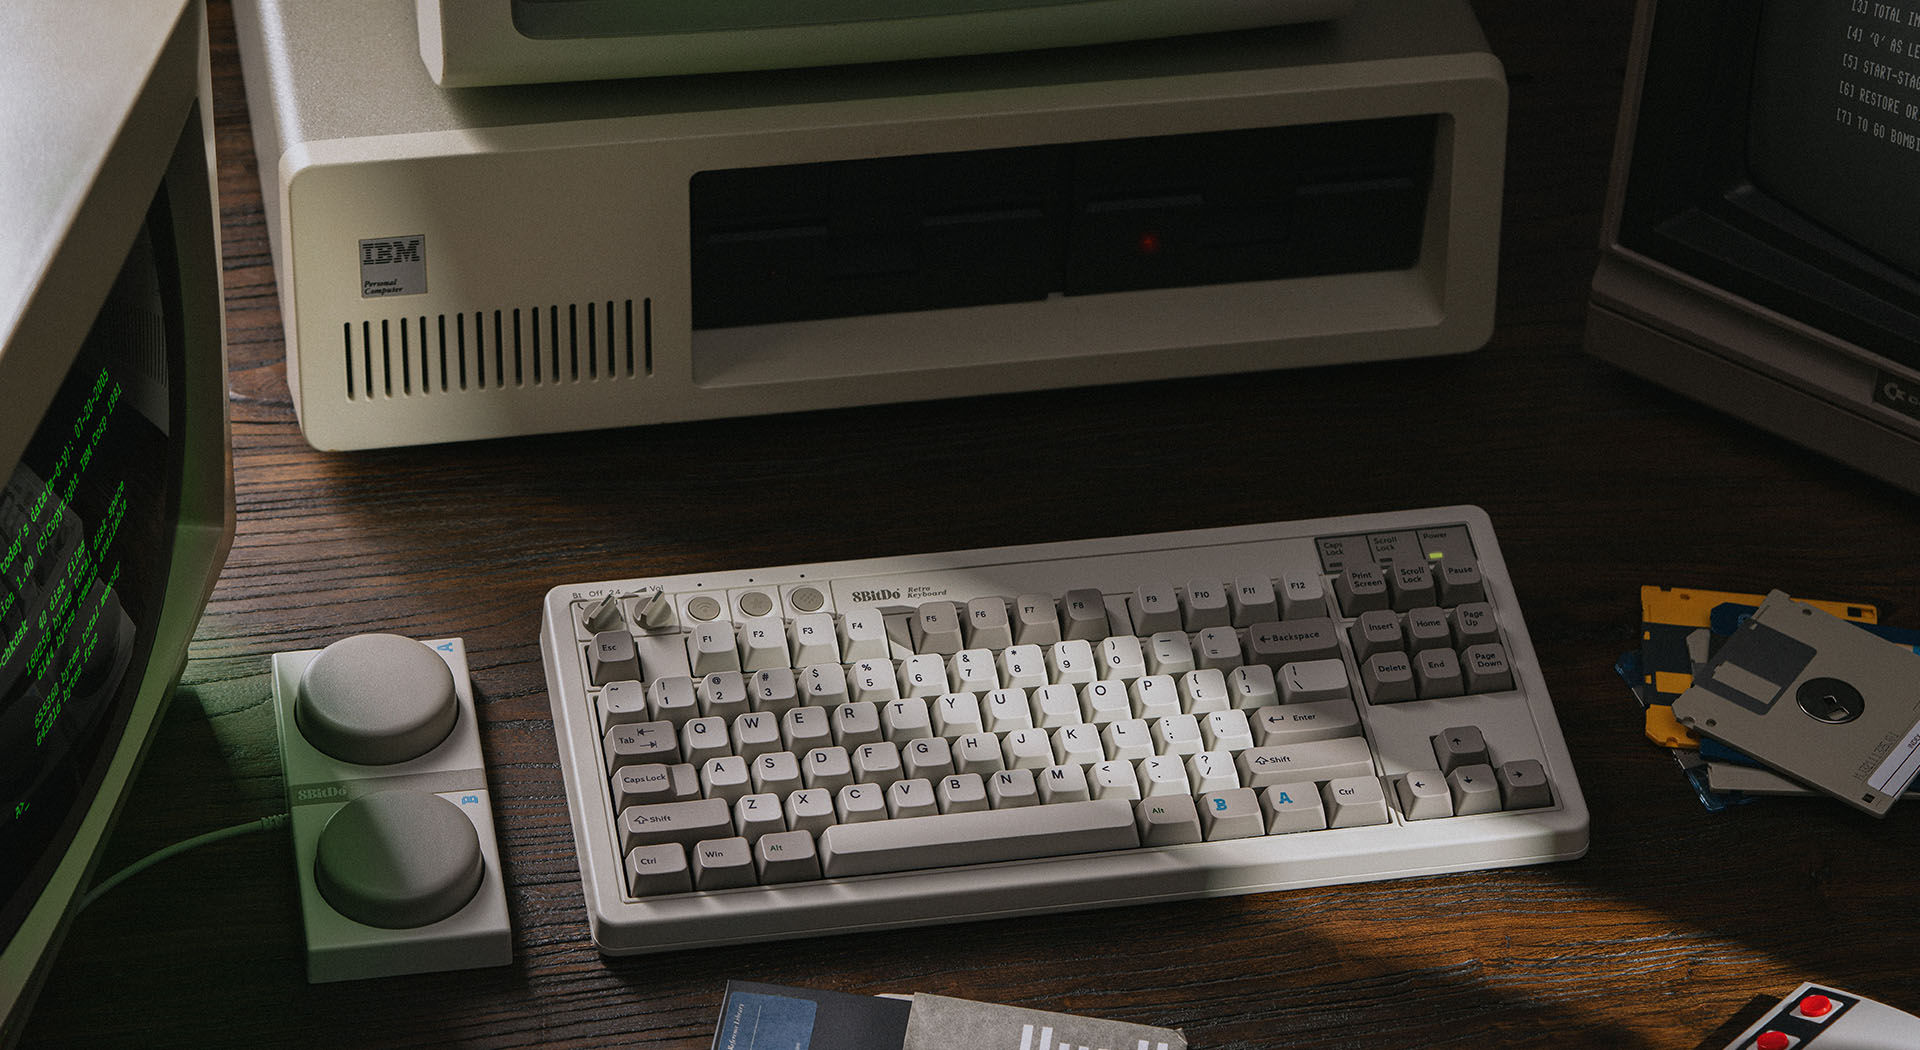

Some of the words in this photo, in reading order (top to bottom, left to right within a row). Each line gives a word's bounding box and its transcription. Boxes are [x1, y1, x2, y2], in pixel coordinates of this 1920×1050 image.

[1873, 3, 1901, 23] TOTAL
[1847, 26, 1863, 42] [4]
[1890, 38, 1903, 54] AS
[1843, 53, 1858, 70] [5]
[1839, 81, 1854, 98] [6]
[1859, 88, 1900, 114] RESTORE
[1905, 104, 1920, 121] OR
[1836, 107, 1852, 125] [7]
[1857, 116, 1869, 132] TO
[1873, 122, 1885, 138] GO
[362, 240, 420, 265] IBM
[364, 278, 398, 288] Personal
[364, 287, 403, 296] Computer
[74, 367, 109, 439] 07-20-2005
[16, 555, 34, 591] 1.00
[80, 444, 93, 472] IBM
[92, 415, 107, 446] Corp
[107, 382, 122, 415] 1981
[1373, 536, 1398, 545] Scroll
[1423, 532, 1447, 540] Power
[1323, 542, 1343, 551] Caps
[1376, 544, 1395, 552] Lock
[1400, 567, 1425, 576] Scroll
[1449, 566, 1473, 574] Pause
[1352, 571, 1372, 580] Print
[1402, 575, 1422, 583] Lock
[39, 609, 47, 630] 40
[50, 578, 66, 612] disk
[67, 540, 85, 578] files
[1291, 582, 1306, 590] F12
[1354, 579, 1383, 588] Screen
[589, 590, 603, 598] Off
[649, 584, 664, 592] Vol
[852, 588, 901, 603] 8BitDo
[907, 589, 947, 599] Keyboard
[1195, 591, 1210, 599] F10
[1243, 586, 1256, 595] F11
[1146, 595, 1158, 603] F9
[1024, 606, 1035, 614] F7
[1073, 602, 1084, 610] F8
[26, 626, 51, 676] 160256
[53, 591, 72, 630] bytes
[75, 550, 92, 589] total
[975, 610, 987, 618] F6
[1463, 609, 1484, 619] Page
[926, 615, 937, 623] F5
[1416, 619, 1441, 628] Home
[1465, 619, 1478, 627] Up
[803, 626, 814, 635] F3
[852, 621, 863, 630] F4
[1369, 622, 1394, 632] Insert
[703, 635, 712, 643] F1
[753, 630, 765, 638] F2
[1271, 631, 1320, 642] Backspace
[38, 645, 54, 681] 6144
[56, 608, 75, 648] bytes
[61, 645, 80, 684] bytes
[82, 604, 99, 645] total
[436, 642, 454, 653] A
[602, 644, 617, 652] Esc
[962, 654, 970, 663] &
[1475, 652, 1496, 661] Page
[63, 664, 82, 703] bytes
[84, 631, 98, 664] free
[861, 663, 872, 672] %
[1014, 664, 1022, 673] 8
[1063, 660, 1071, 669] 9
[1378, 663, 1406, 673] Delete
[1428, 661, 1445, 669] End
[1477, 660, 1503, 668] Down
[762, 672, 769, 681] #
[812, 668, 819, 678] $
[915, 673, 923, 683] 6
[965, 668, 973, 678] 7
[712, 676, 722, 685] @
[866, 678, 874, 687] 5
[1143, 680, 1153, 691] P
[765, 687, 772, 697] 3
[815, 683, 822, 692] 4
[1095, 685, 1107, 696] O
[716, 691, 723, 700] 2
[994, 693, 1006, 705] U
[1044, 689, 1049, 700] I
[664, 696, 669, 705] 1
[946, 698, 956, 709] Y
[844, 707, 855, 719] R
[894, 703, 904, 714] T
[795, 712, 804, 724] E
[1293, 713, 1316, 722] Enter
[744, 717, 760, 729] W
[694, 723, 706, 734] Q
[1116, 724, 1126, 735] L
[1017, 733, 1026, 744] J
[1066, 729, 1078, 740] K
[618, 736, 635, 745] Tab
[966, 738, 978, 749] H
[864, 747, 873, 758] F
[916, 743, 929, 754] G
[815, 752, 828, 763] D
[1201, 755, 1210, 764] ?
[1270, 755, 1291, 764] Shift
[714, 762, 725, 773] A
[764, 757, 776, 769] S
[1001, 774, 1012, 785] N
[1051, 769, 1064, 780] M
[951, 779, 961, 789] B
[299, 785, 348, 801] 8BitDo
[850, 789, 861, 799] C
[900, 784, 911, 795] V
[1339, 788, 1355, 796] Ctrl
[461, 795, 479, 805] B
[799, 794, 809, 805] X
[1279, 791, 1293, 804] A
[748, 799, 758, 809] Z
[1213, 798, 1228, 811] B
[1152, 806, 1165, 815] Alt
[649, 814, 672, 823] Shift
[770, 844, 784, 852] Alt
[705, 850, 724, 858] Win
[640, 857, 657, 866] Ctrl
